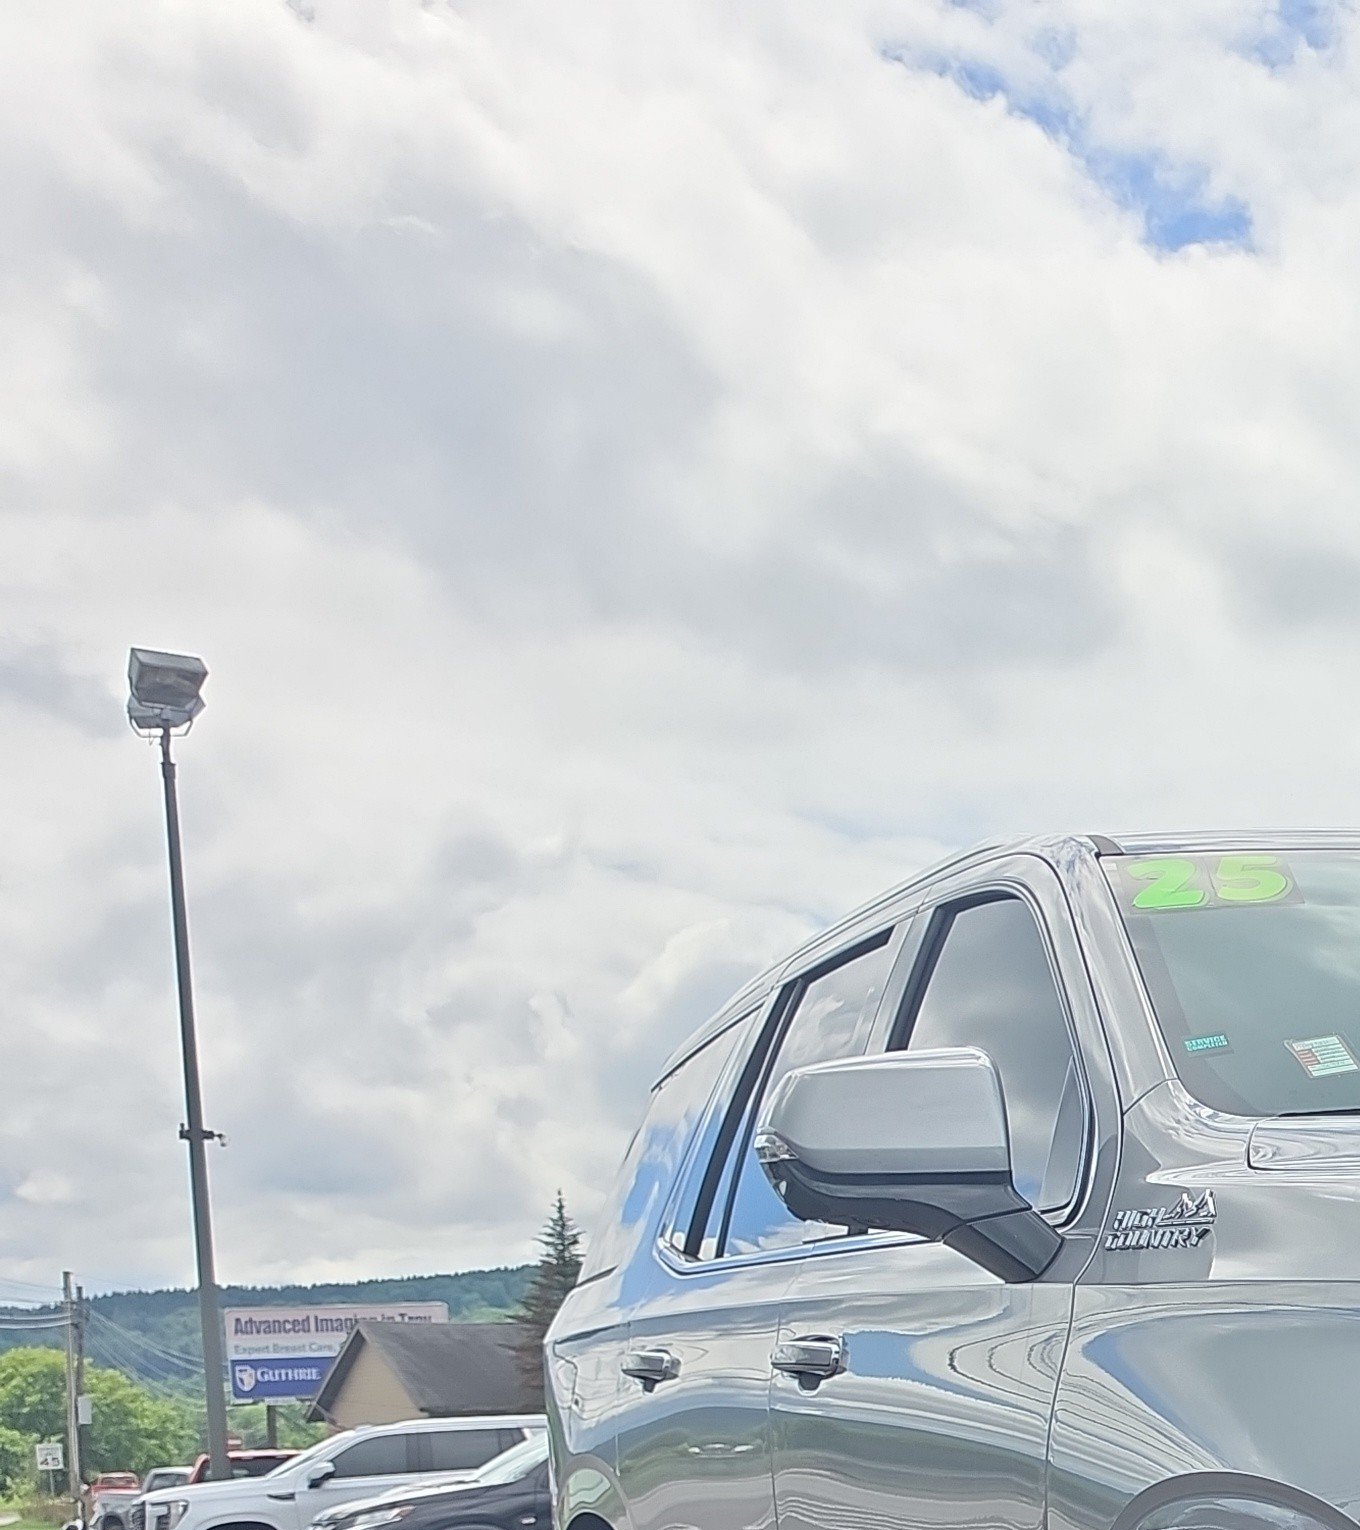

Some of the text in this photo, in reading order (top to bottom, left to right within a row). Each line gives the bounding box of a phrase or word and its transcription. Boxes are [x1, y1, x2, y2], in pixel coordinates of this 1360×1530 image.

[1126, 856, 1290, 909] 25
[1114, 1208, 1166, 1230] HIGH
[1104, 1227, 1210, 1250] COUNTRY
[234, 1315, 311, 1336] Advanced
[256, 1367, 322, 1382] GUTHRIE
